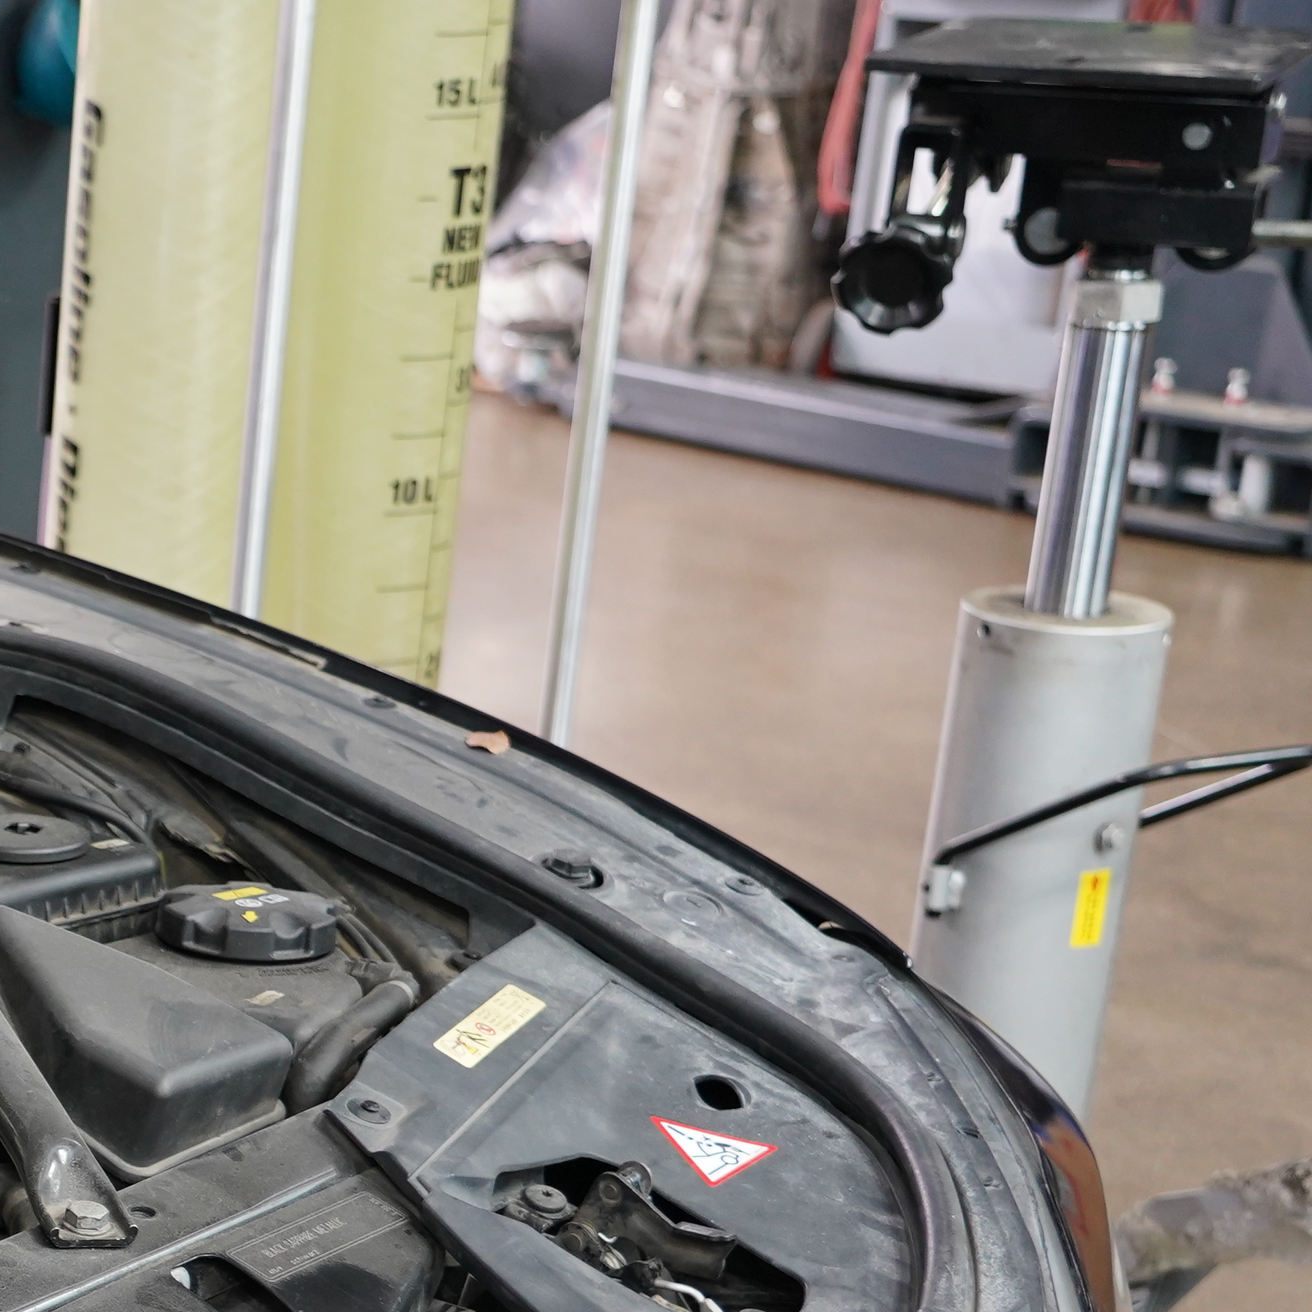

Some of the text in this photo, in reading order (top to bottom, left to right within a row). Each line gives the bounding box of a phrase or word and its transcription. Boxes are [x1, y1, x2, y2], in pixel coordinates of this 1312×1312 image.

[435, 78, 478, 108] 15 L
[389, 476, 434, 505] 10 L
